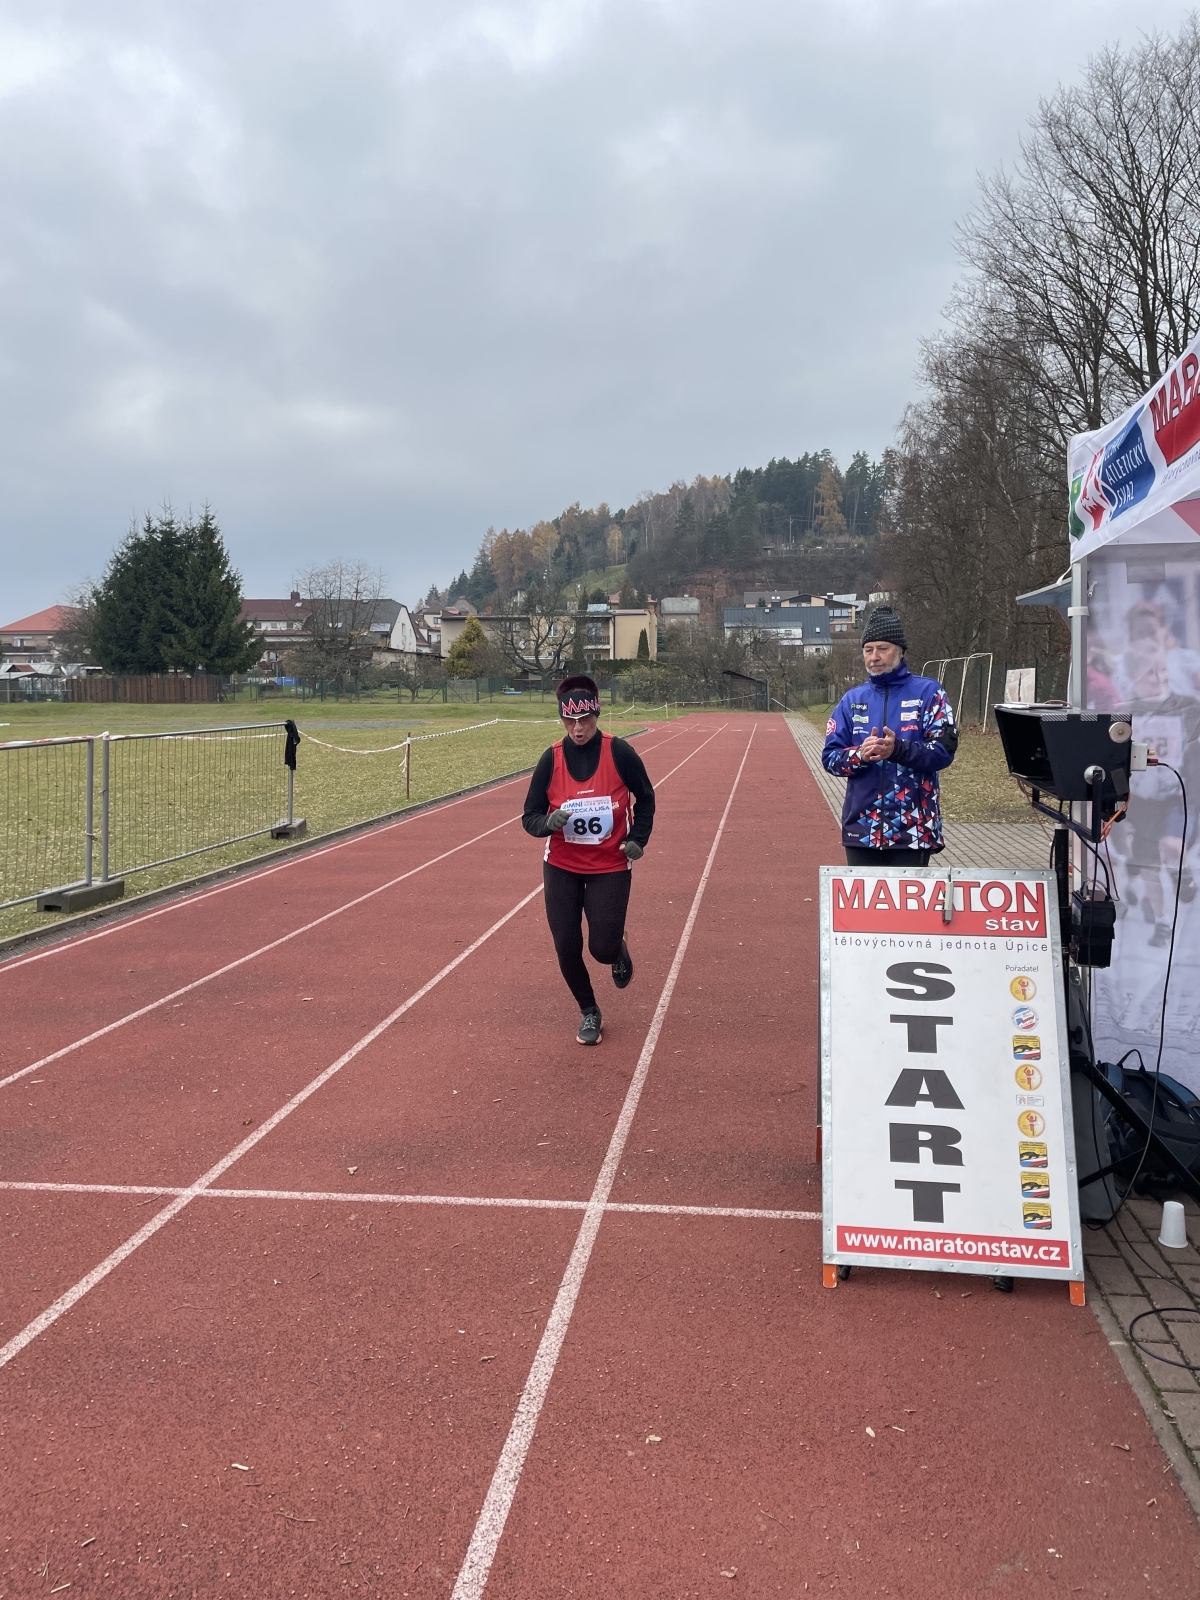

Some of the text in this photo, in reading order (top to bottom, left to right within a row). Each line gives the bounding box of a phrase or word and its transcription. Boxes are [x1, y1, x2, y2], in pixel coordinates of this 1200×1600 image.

[1105, 437, 1146, 485] ATLETICKÝ
[1117, 481, 1135, 507] SVAZ
[573, 816, 603, 836] 86
[832, 878, 1045, 914] MARATON
[985, 916, 1040, 932] stav
[834, 936, 1049, 953] tělovýchovná jednota Úpice
[1005, 964, 1039, 973] Pořadatel
[884, 961, 966, 1224] START
[844, 1232, 1061, 1261] www.maratonstav.cz
